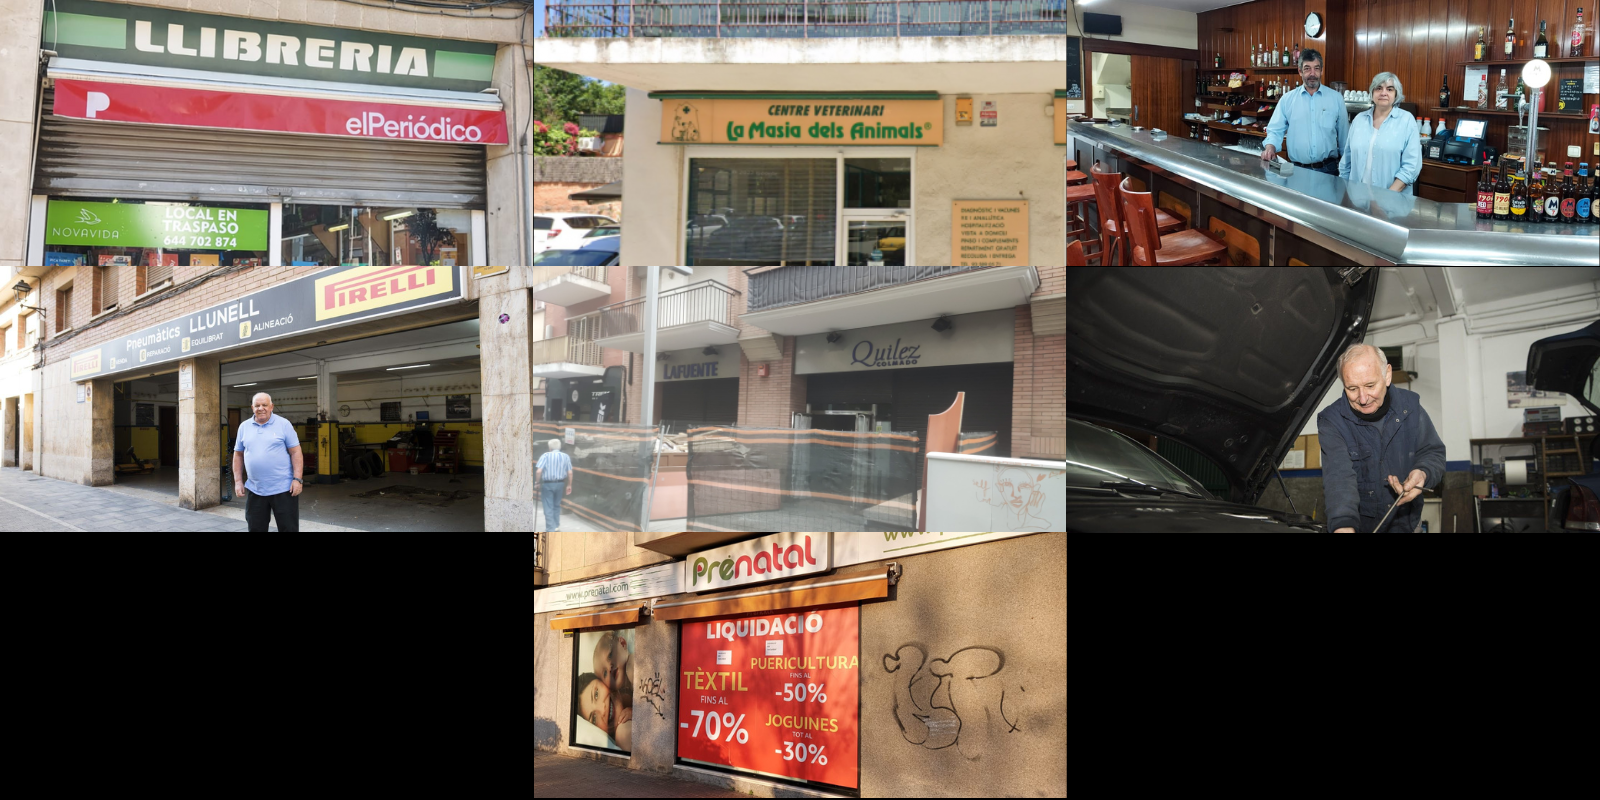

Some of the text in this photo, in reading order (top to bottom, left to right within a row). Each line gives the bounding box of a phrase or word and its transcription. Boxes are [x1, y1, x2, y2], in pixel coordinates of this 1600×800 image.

[135, 20, 428, 77] LLIBRERIA
[768, 105, 884, 116] CENTRE VETERINARI
[346, 111, 482, 142] elPeriódico
[727, 121, 744, 141] La
[748, 121, 801, 140] Masia
[808, 122, 844, 139] dels
[1548, 199, 1558, 209] M
[165, 207, 237, 221] LOCAL EN
[52, 227, 119, 239] NOVAVIDA
[163, 220, 239, 234] TRASPASO
[164, 235, 237, 247] 644 702 874
[324, 266, 436, 310] PIRELLI
[127, 299, 260, 351] Pneumàtics LLUNELL
[253, 315, 293, 332] ALINEACIÓ
[191, 333, 224, 347] EQUILIBRAT
[147, 345, 171, 357] REPARACIÓ
[850, 340, 922, 368] Quilez
[73, 354, 98, 374] PIRELLI
[663, 361, 719, 380] LAFUENTE
[876, 359, 918, 367] COLMADO
[706, 608, 823, 641] LIQUIDACIÓ
[751, 655, 859, 670] PUERICULTURA
[684, 667, 748, 691] TÈXTIL
[700, 695, 728, 705] FINS AL
[775, 682, 827, 703] -50%
[680, 710, 749, 744] -70%
[765, 713, 838, 732] JOGUINES
[775, 741, 828, 766] -30%
